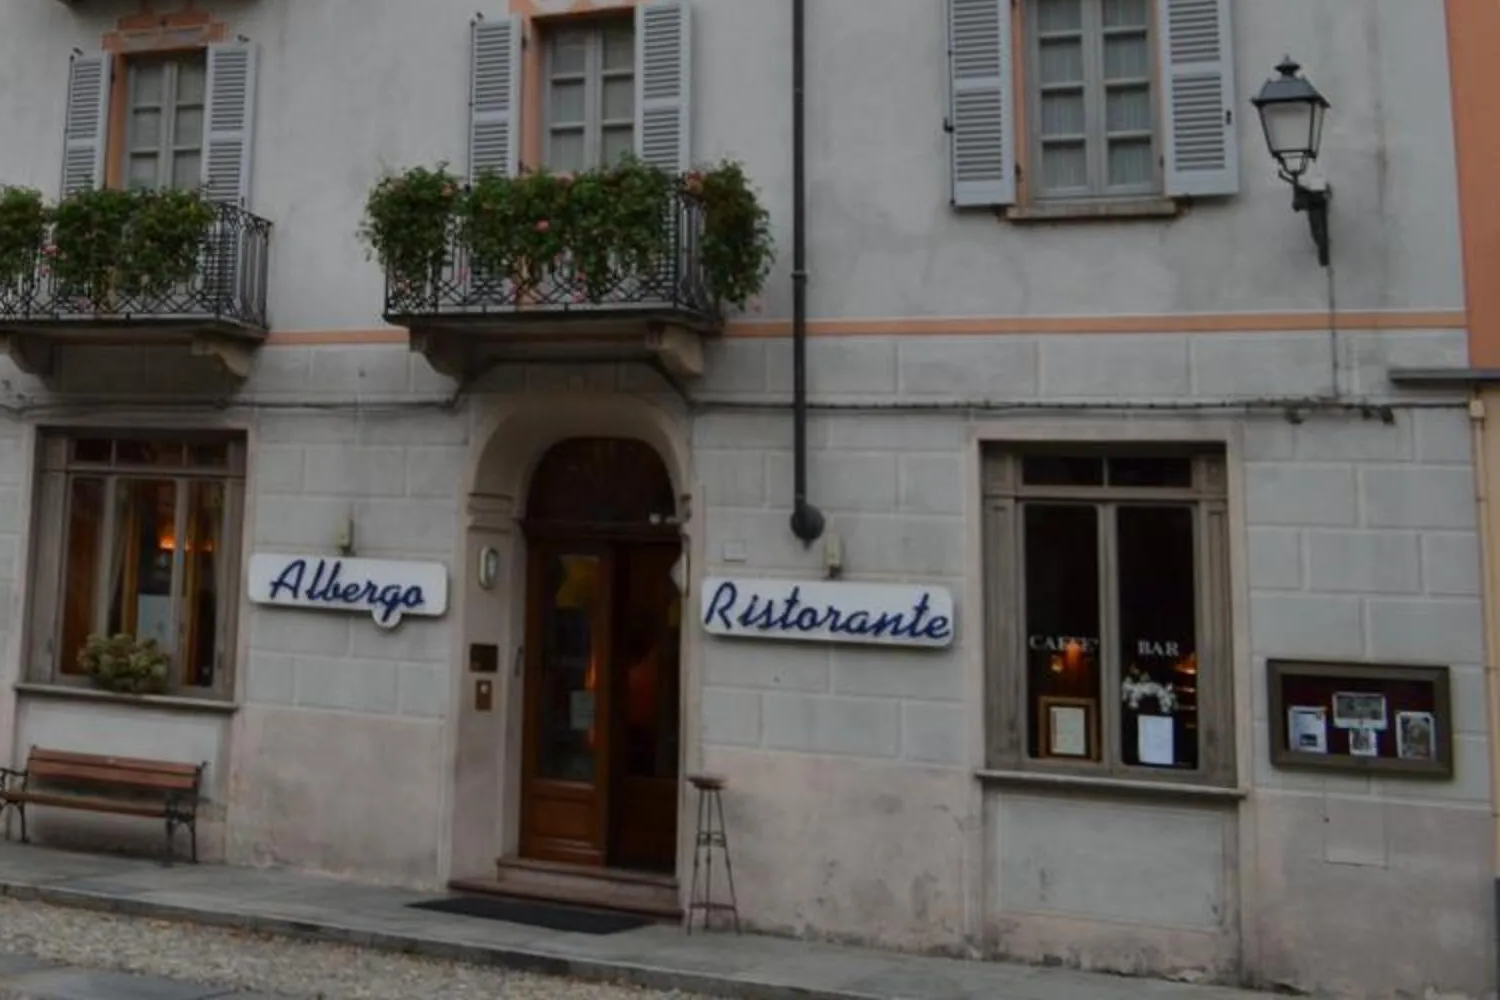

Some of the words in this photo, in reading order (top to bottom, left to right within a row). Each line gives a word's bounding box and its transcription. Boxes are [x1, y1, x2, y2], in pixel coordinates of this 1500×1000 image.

[269, 559, 425, 623] Albergo
[704, 580, 950, 639] Ristorante
[1137, 639, 1180, 657] BAR
